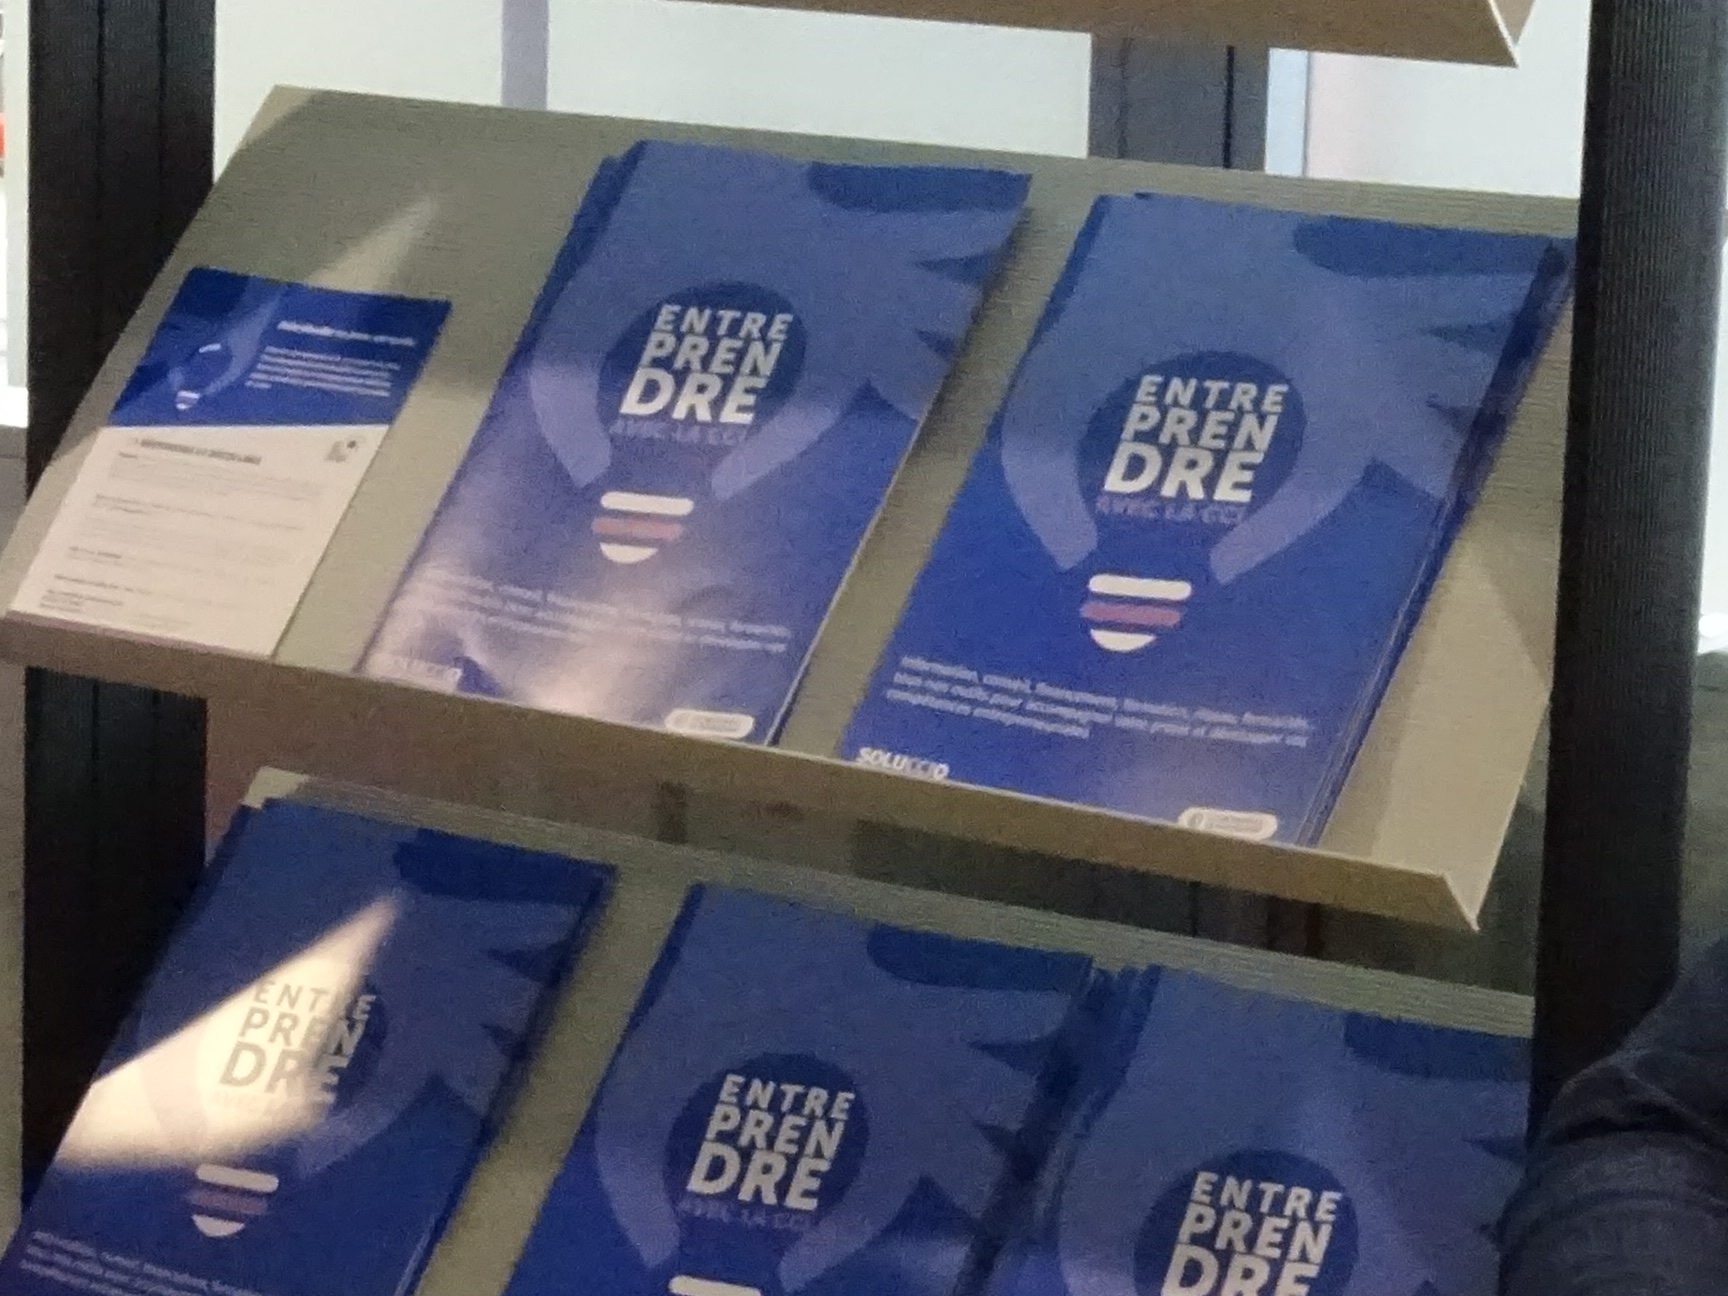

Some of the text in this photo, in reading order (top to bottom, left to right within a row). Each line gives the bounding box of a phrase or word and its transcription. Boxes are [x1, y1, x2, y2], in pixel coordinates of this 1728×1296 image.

[653, 304, 793, 341] ENTRE
[639, 331, 784, 376] PREN
[619, 366, 769, 424] DRE
[1135, 374, 1289, 413] ENTRE
[1121, 403, 1279, 452] PREN
[1104, 441, 1264, 503] DRE
[253, 981, 377, 1021] ENTE
[239, 1006, 366, 1056] PREN
[219, 1041, 351, 1106] DRE
[719, 1073, 855, 1120] ENTRE
[705, 1104, 845, 1160] PREN
[686, 1141, 832, 1211] DRE
[1190, 1171, 1343, 1222] ENTRE
[1178, 1202, 1333, 1264] PREN
